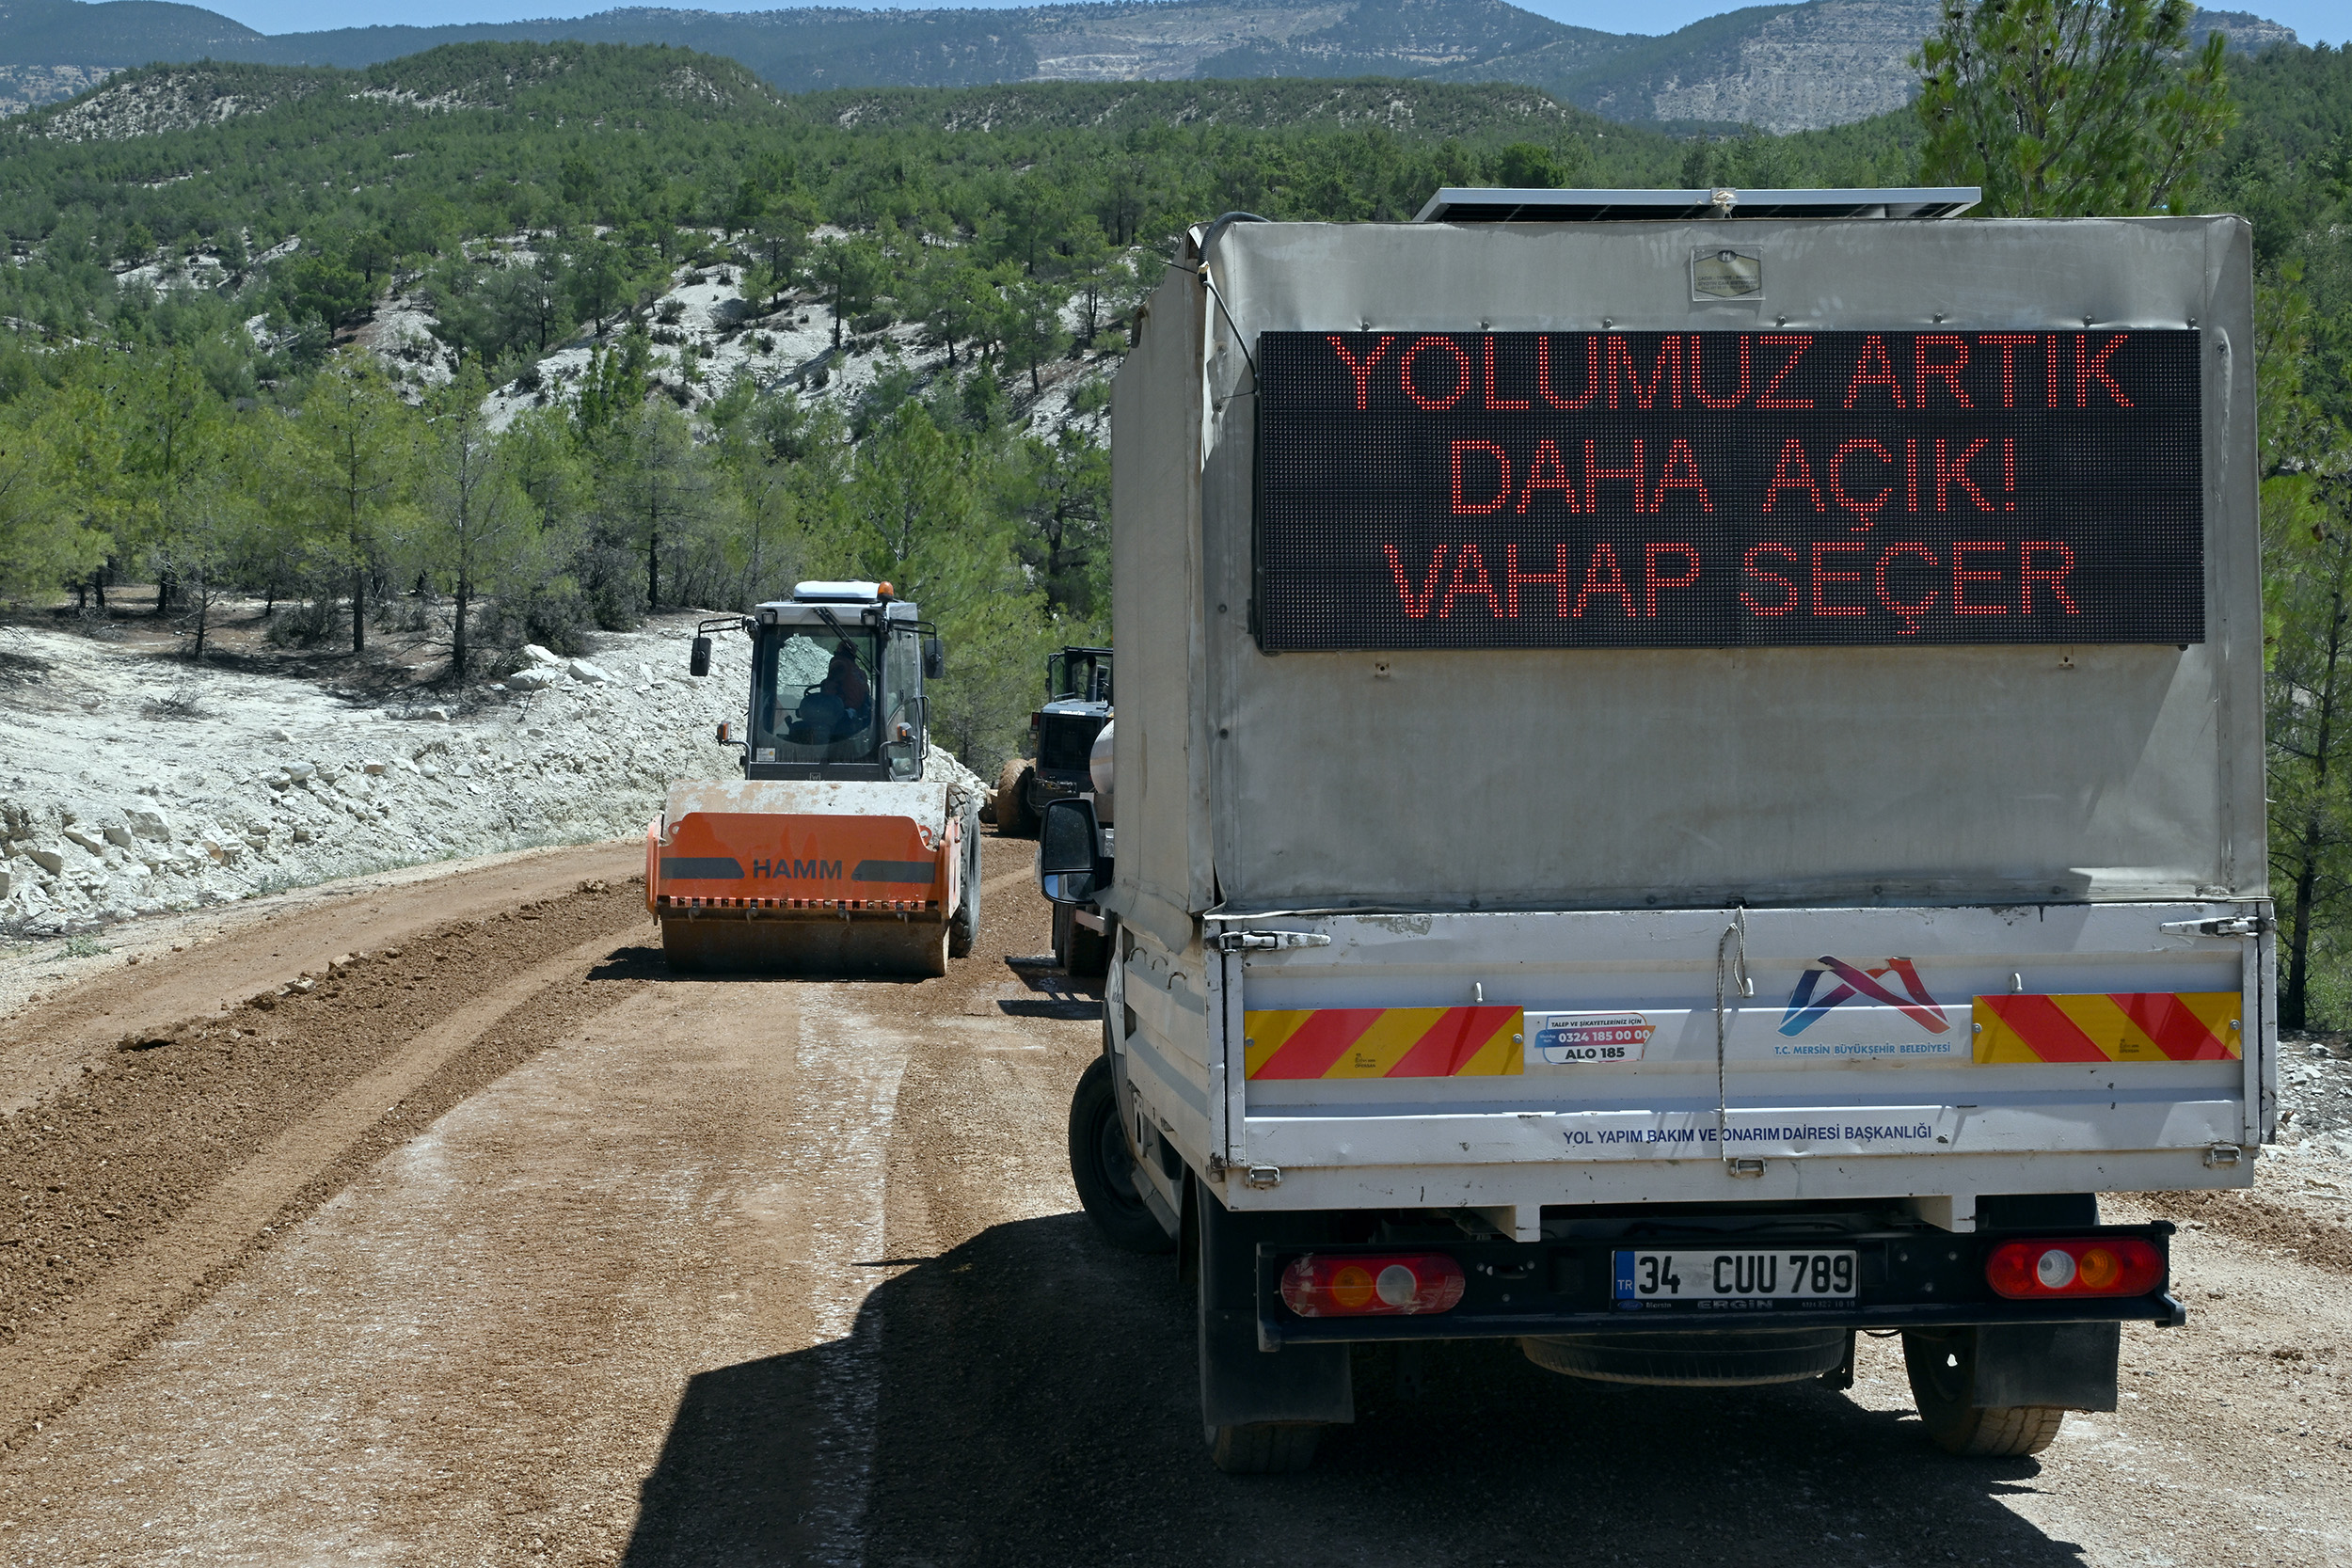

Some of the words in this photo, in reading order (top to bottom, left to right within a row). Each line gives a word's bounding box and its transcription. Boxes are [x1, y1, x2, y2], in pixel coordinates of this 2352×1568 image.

[1327, 335, 1814, 409] YOLUMUZ
[1844, 335, 2134, 408] ARTIK
[1452, 438, 1712, 515] DAHA
[1763, 437, 2016, 531] AÇIK!
[1384, 542, 1700, 619] VAHAP
[1740, 542, 2080, 635] SEÇER
[754, 859, 842, 879] HAMM
[1580, 1019, 1627, 1027] ŞİKAYETLERİNİZ
[1558, 1032, 1589, 1043] 0324
[1593, 1031, 1613, 1042] 185
[1615, 1030, 1632, 1040] 00
[1634, 1029, 1650, 1039] 00
[1565, 1048, 1597, 1059] ALO
[1600, 1047, 1626, 1058] 185
[1774, 1046, 1790, 1054] T.C.
[1793, 1043, 1830, 1054] MERSİN
[1835, 1042, 1896, 1056] BÜYÜKŞEHİR
[1899, 1041, 1950, 1053] BELEDİYESİ
[1563, 1131, 1593, 1145] YOL
[1597, 1130, 1643, 1144] YAPIM
[1647, 1129, 1693, 1143] BAKIM
[1698, 1128, 1717, 1142] VE
[1723, 1128, 1780, 1141] ONARIM
[1783, 1123, 1840, 1140] DAİRESİ
[1845, 1122, 1931, 1142] BAŞKANLIĞI
[1617, 1279, 1632, 1291] TR
[1639, 1256, 1680, 1294] 34
[1713, 1255, 1777, 1294] CUU
[1788, 1255, 1853, 1294] 789
